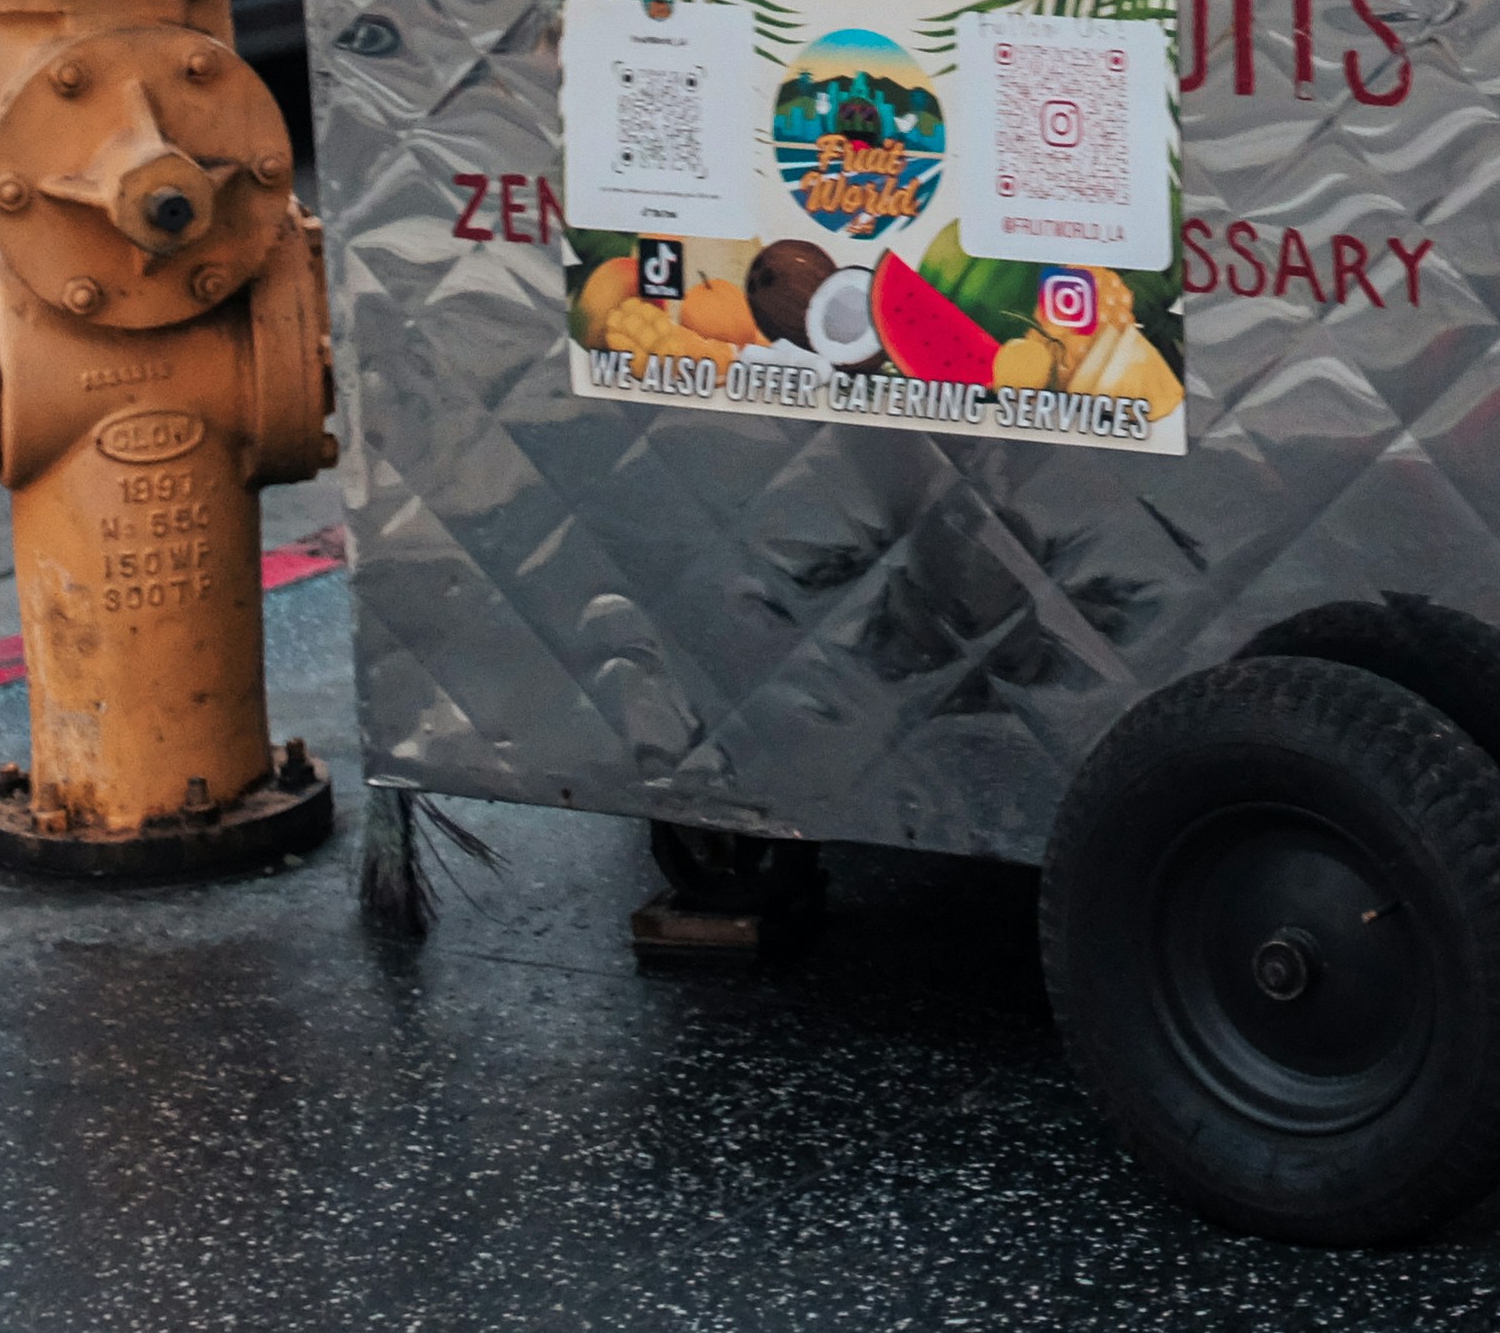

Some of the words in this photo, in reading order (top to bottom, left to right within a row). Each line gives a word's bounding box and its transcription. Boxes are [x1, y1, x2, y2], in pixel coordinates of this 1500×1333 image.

[815, 133, 907, 176] Fruit
[798, 170, 921, 217] World
[590, 348, 637, 391] WE
[640, 353, 715, 399] ALSO
[725, 359, 821, 409] OFFER
[828, 367, 989, 425] CATERING
[997, 384, 1154, 440] SERVICES
